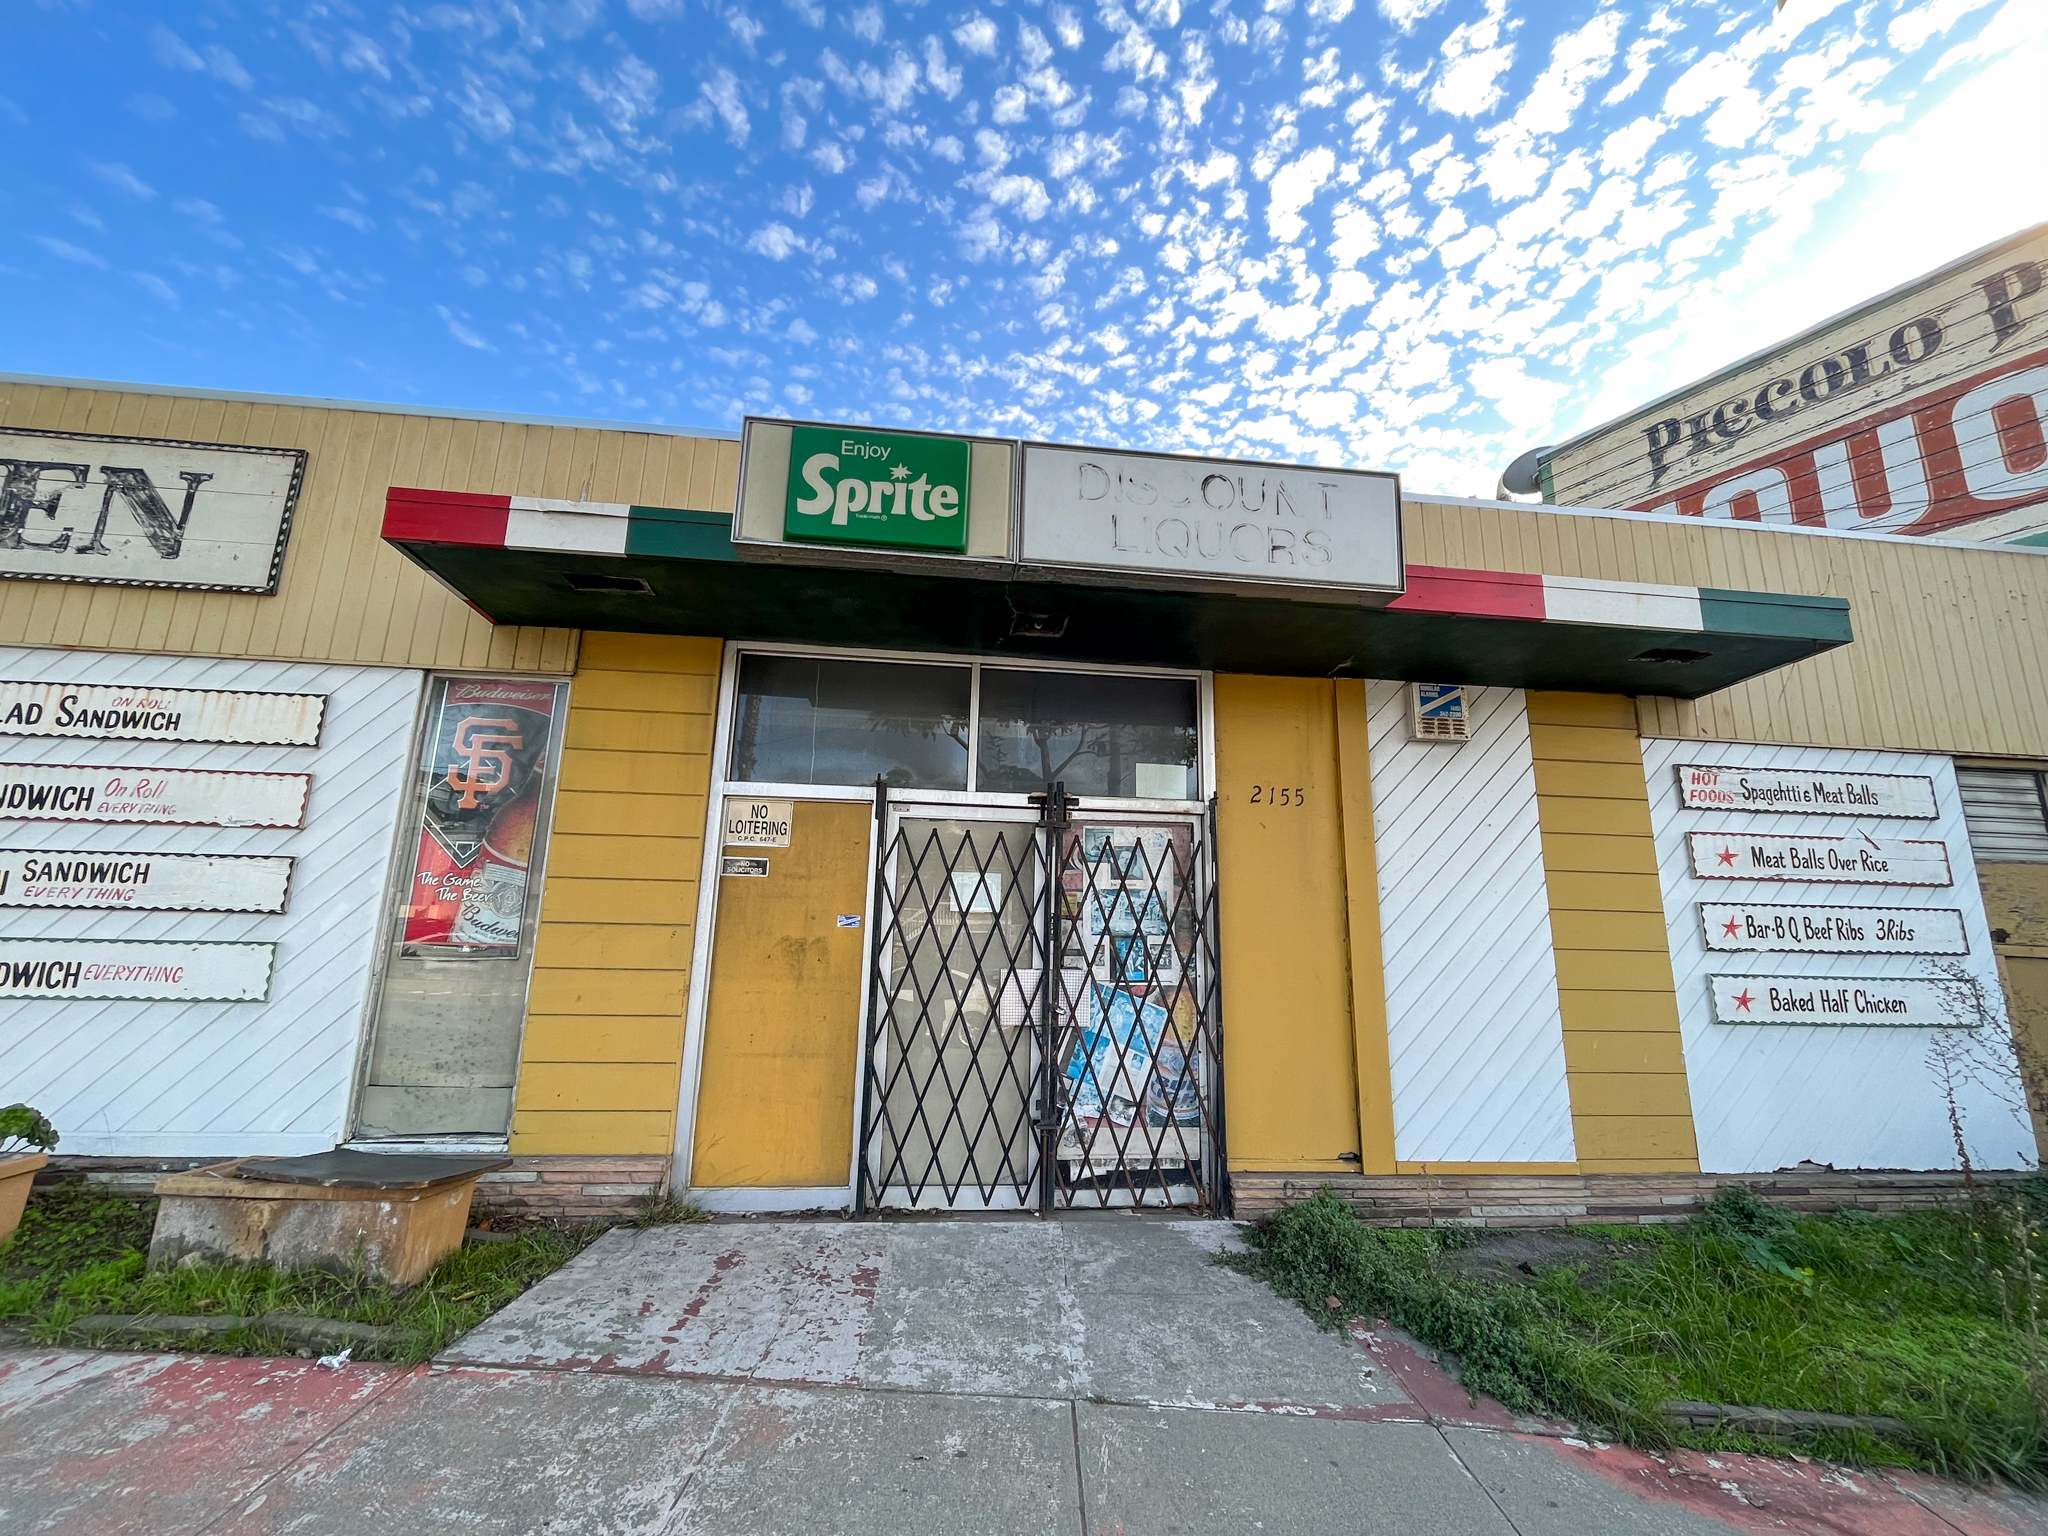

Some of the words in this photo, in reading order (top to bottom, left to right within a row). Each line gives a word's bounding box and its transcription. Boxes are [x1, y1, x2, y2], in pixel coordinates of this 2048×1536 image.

[1641, 315, 1946, 488] PICCOLO
[841, 440, 891, 460] Enjoy
[797, 453, 959, 525] Sprite
[112, 697, 134, 707] ON
[456, 684, 551, 700] Budweiser
[0, 703, 43, 725] AD
[104, 778, 124, 798] On
[134, 779, 168, 799] Roll
[1691, 772, 1719, 786] HOT
[1250, 785, 1304, 807] 2155
[1690, 789, 1734, 804] FOODS
[1739, 777, 1801, 806] Spagehtti
[1813, 782, 1844, 804] Meat
[1846, 783, 1878, 806] Balls
[97, 802, 177, 816] EVERYTHING
[751, 805, 768, 819] NO
[729, 820, 788, 836] LOITERING
[1751, 846, 1786, 869] Meat
[1791, 848, 1824, 870] Balls
[1828, 850, 1857, 872] Over
[1860, 851, 1889, 873] Rice
[22, 859, 150, 885] SANDWICH
[417, 871, 438, 885] The
[443, 872, 482, 887] Game.
[24, 886, 135, 901] EVERYTHING
[436, 887, 457, 901] The
[1803, 917, 1832, 941] Beef
[1836, 918, 1864, 941] Ribs
[83, 964, 184, 984] EVERYTHING
[1769, 988, 1814, 1013] Baked
[1821, 989, 1849, 1013] Half
[1853, 990, 1907, 1015] Chicken
